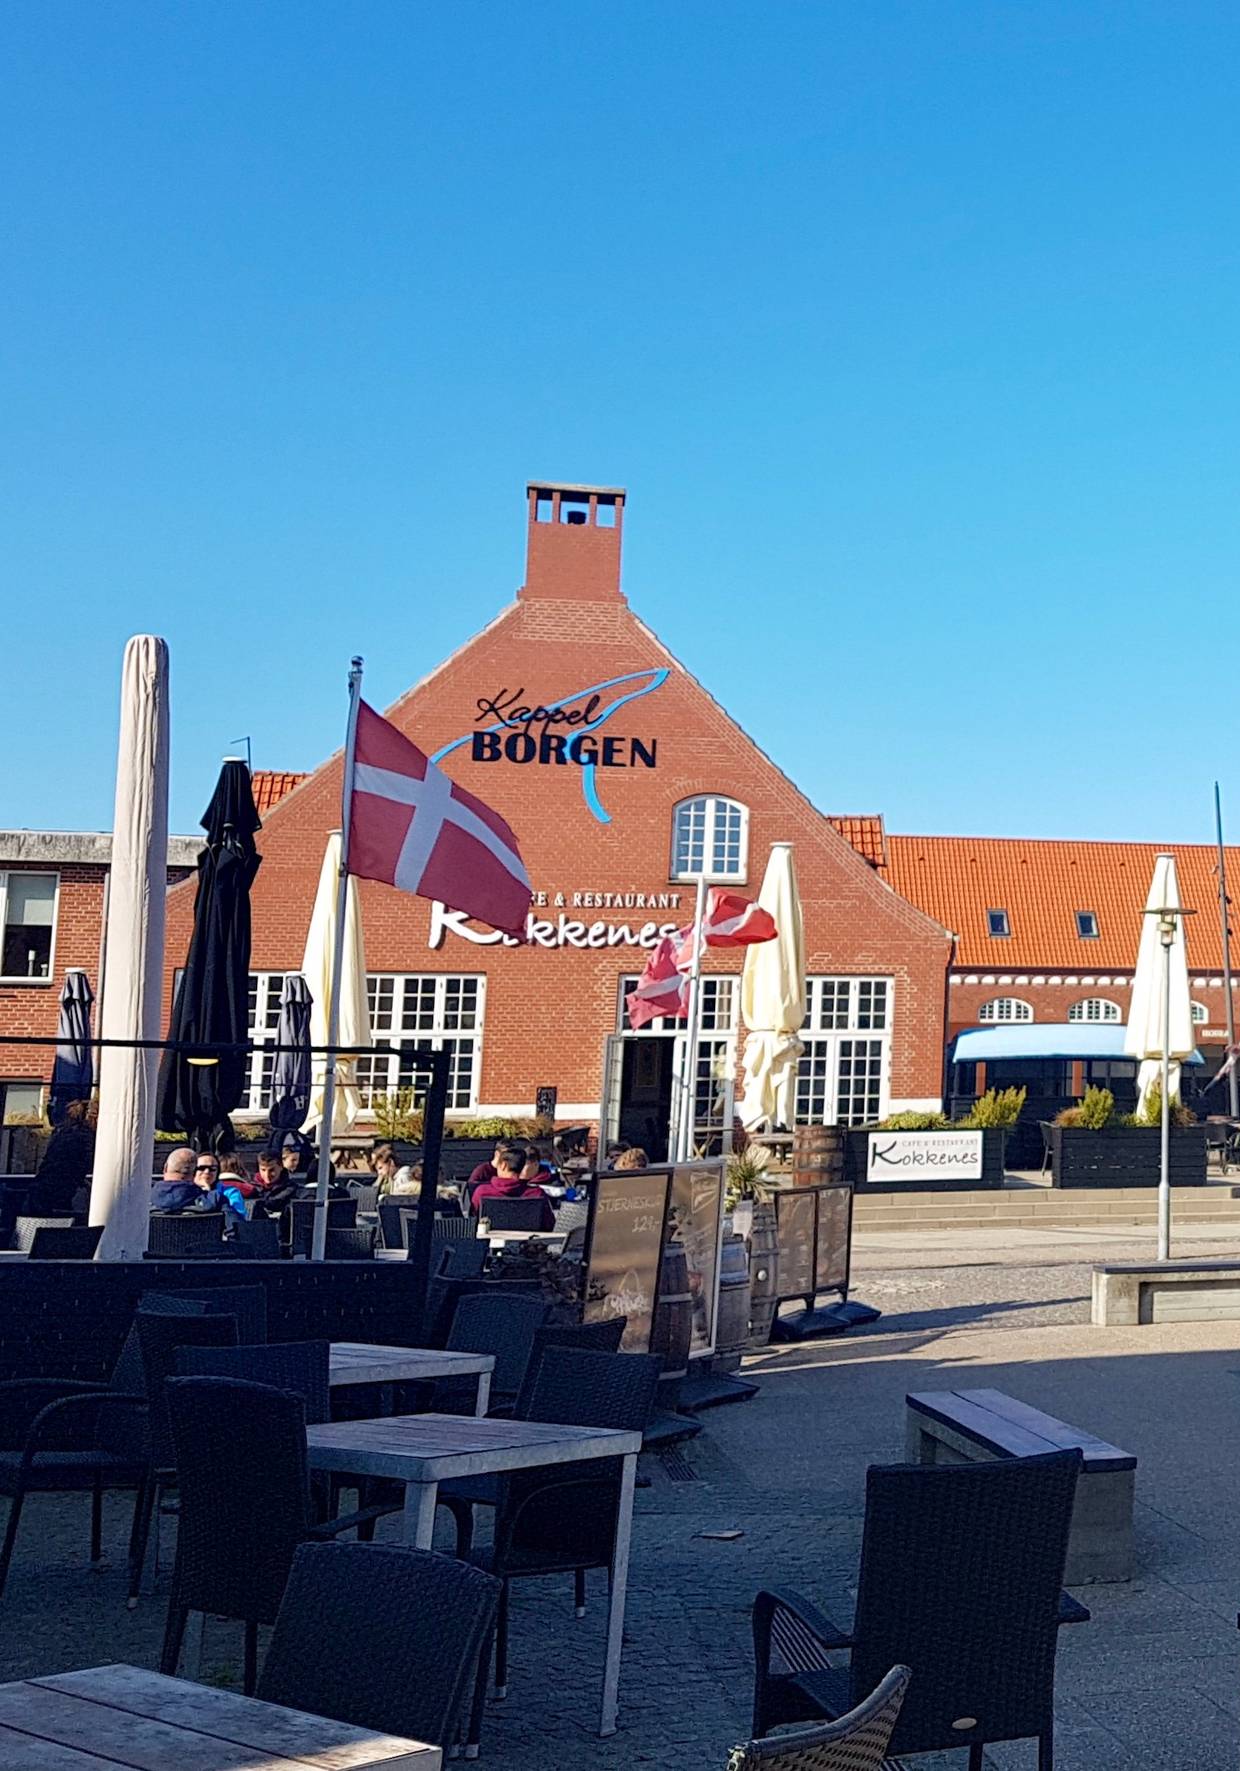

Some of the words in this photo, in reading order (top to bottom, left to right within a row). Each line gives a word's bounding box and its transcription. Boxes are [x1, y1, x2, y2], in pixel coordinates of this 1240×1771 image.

[475, 688, 606, 738] Kappel
[471, 731, 657, 768] BORGEN
[573, 892, 679, 909] RESTAURANT
[428, 899, 678, 949] Kkkenes
[871, 1140, 978, 1168] Kokkenes
